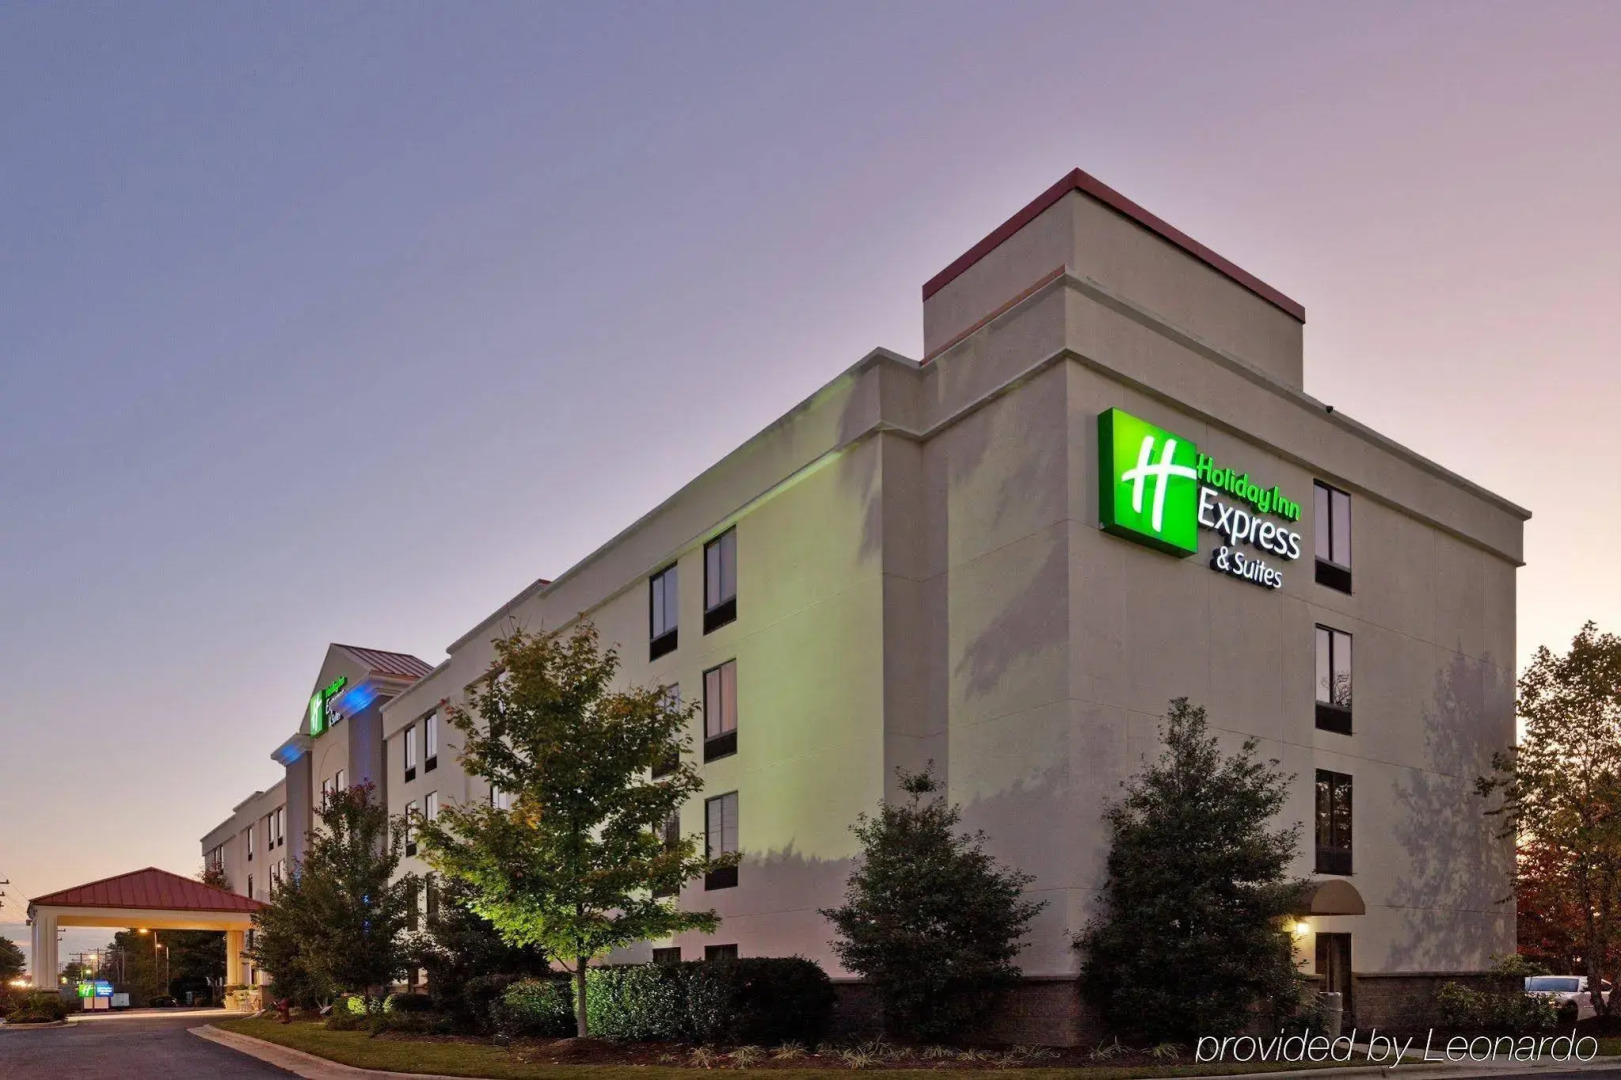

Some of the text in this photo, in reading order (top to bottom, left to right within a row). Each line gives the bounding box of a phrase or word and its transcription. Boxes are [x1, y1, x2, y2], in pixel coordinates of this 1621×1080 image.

[1197, 452, 1301, 521] Holiday Inn
[1197, 486, 1301, 560] Express
[1216, 546, 1283, 589] & Suites
